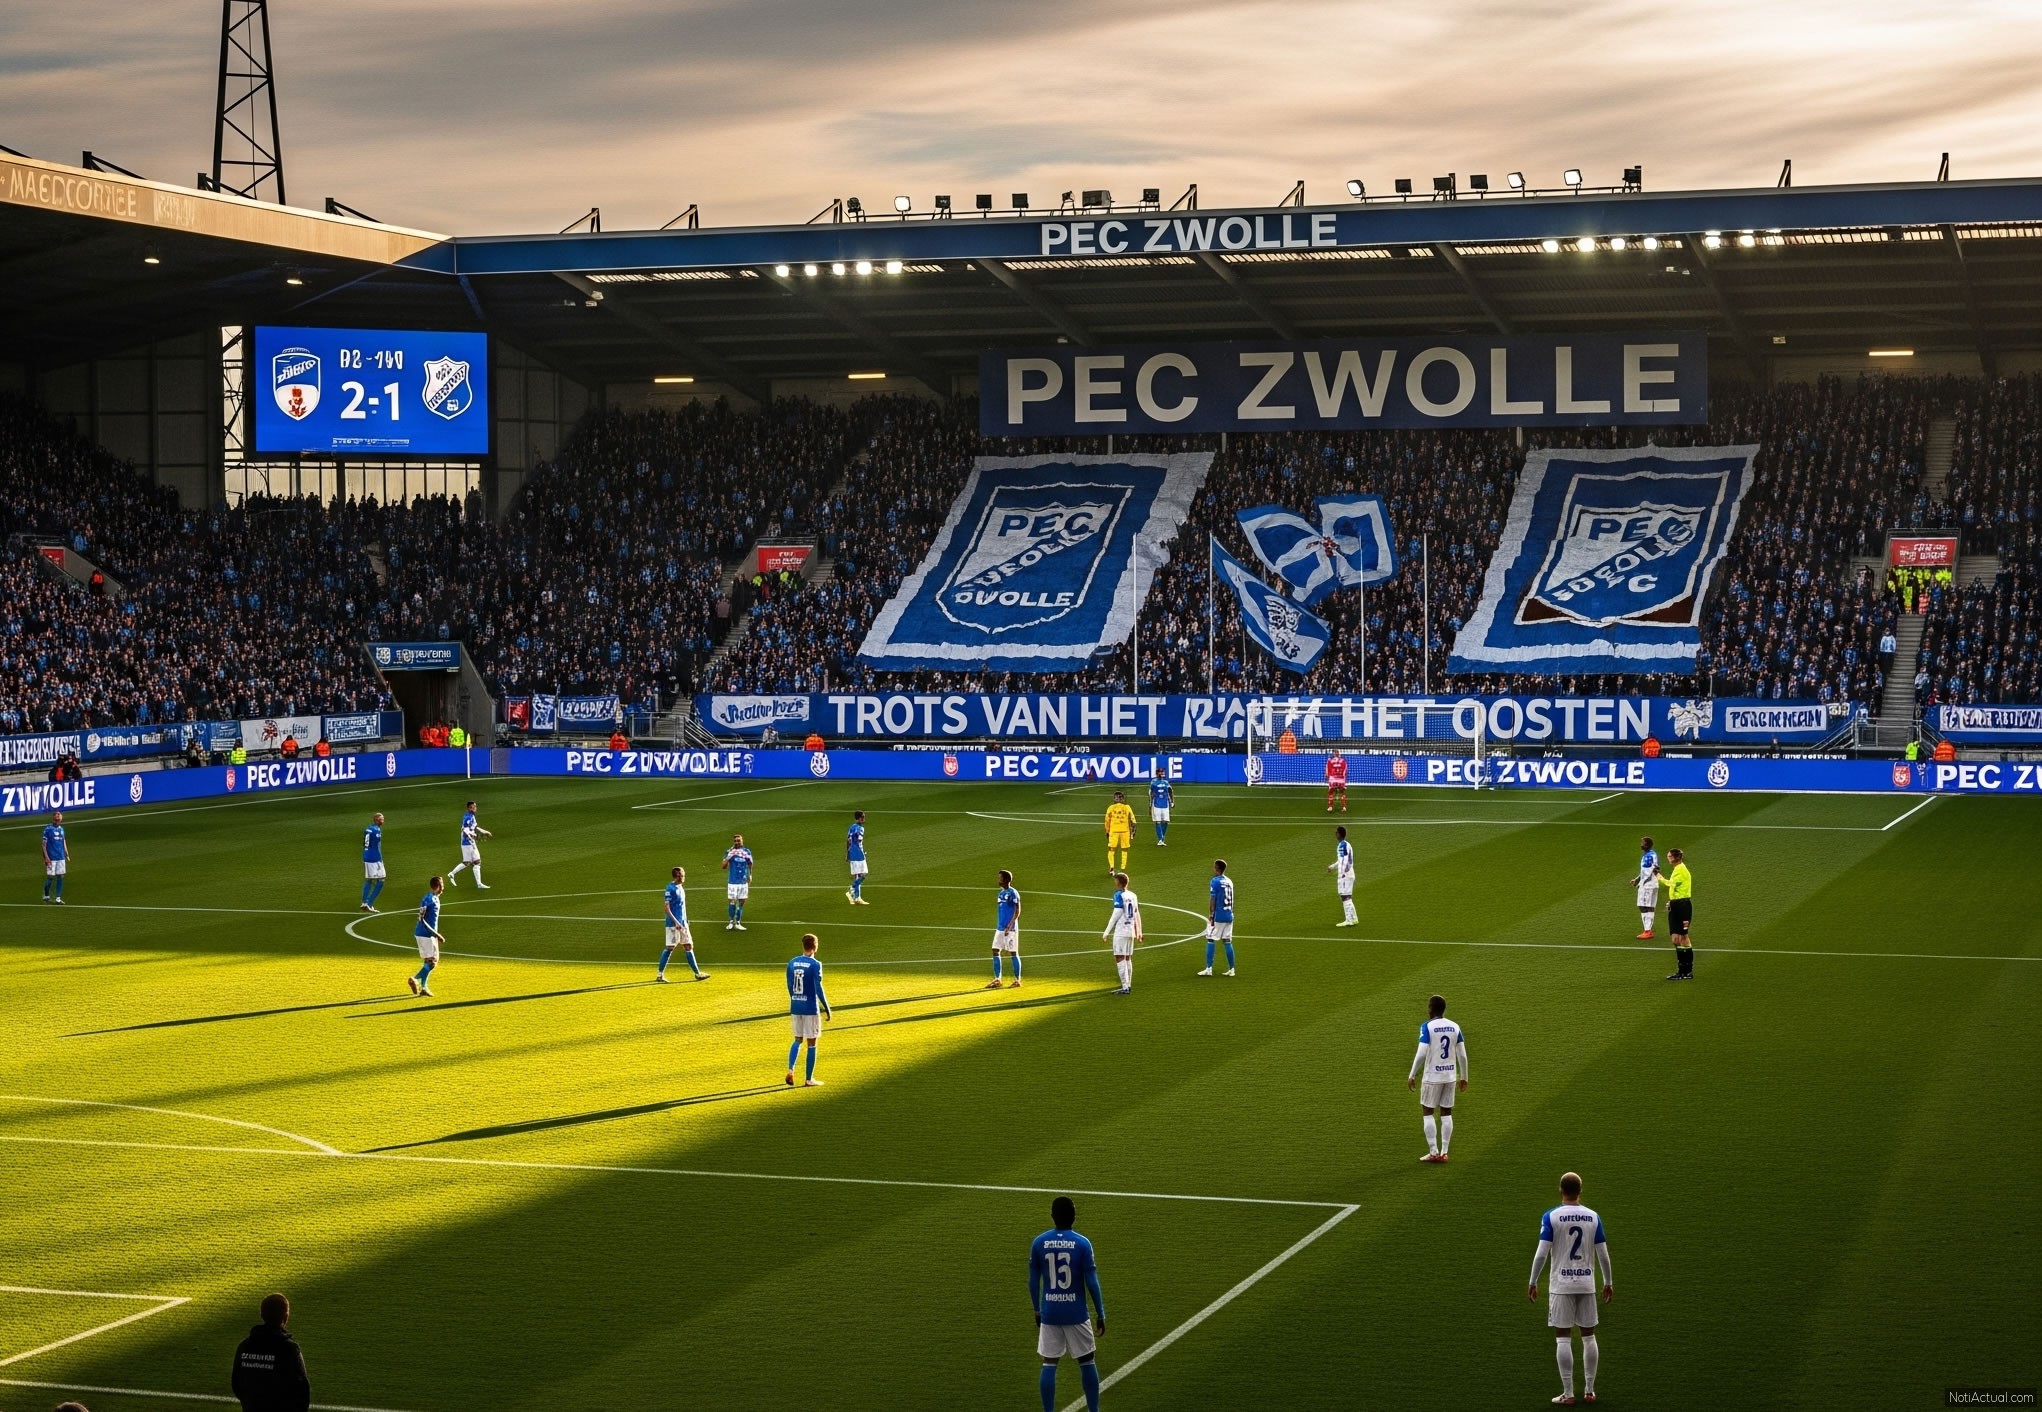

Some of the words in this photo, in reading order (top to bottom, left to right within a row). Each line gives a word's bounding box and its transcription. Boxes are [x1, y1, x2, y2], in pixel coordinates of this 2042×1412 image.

[1041, 220, 1129, 255] PEC
[1143, 213, 1337, 252] ZWOLLE
[1007, 352, 1199, 424] PEC
[1237, 343, 1680, 420] ZWOLLE
[997, 512, 1094, 538] PEC
[828, 695, 968, 735] TROTS
[981, 696, 1067, 735] VAN
[1081, 696, 1166, 736] HET
[1341, 697, 1436, 739] HET
[1452, 698, 1650, 741] OOSTEN
[567, 751, 613, 774] PEC
[986, 755, 1039, 778] PEC
[1427, 759, 1485, 783] PEC
[247, 764, 280, 789] PEC
[1937, 764, 2001, 790] PEC
[1569, 1226, 1583, 1260] 2
[1045, 1252, 1072, 1290] 13
